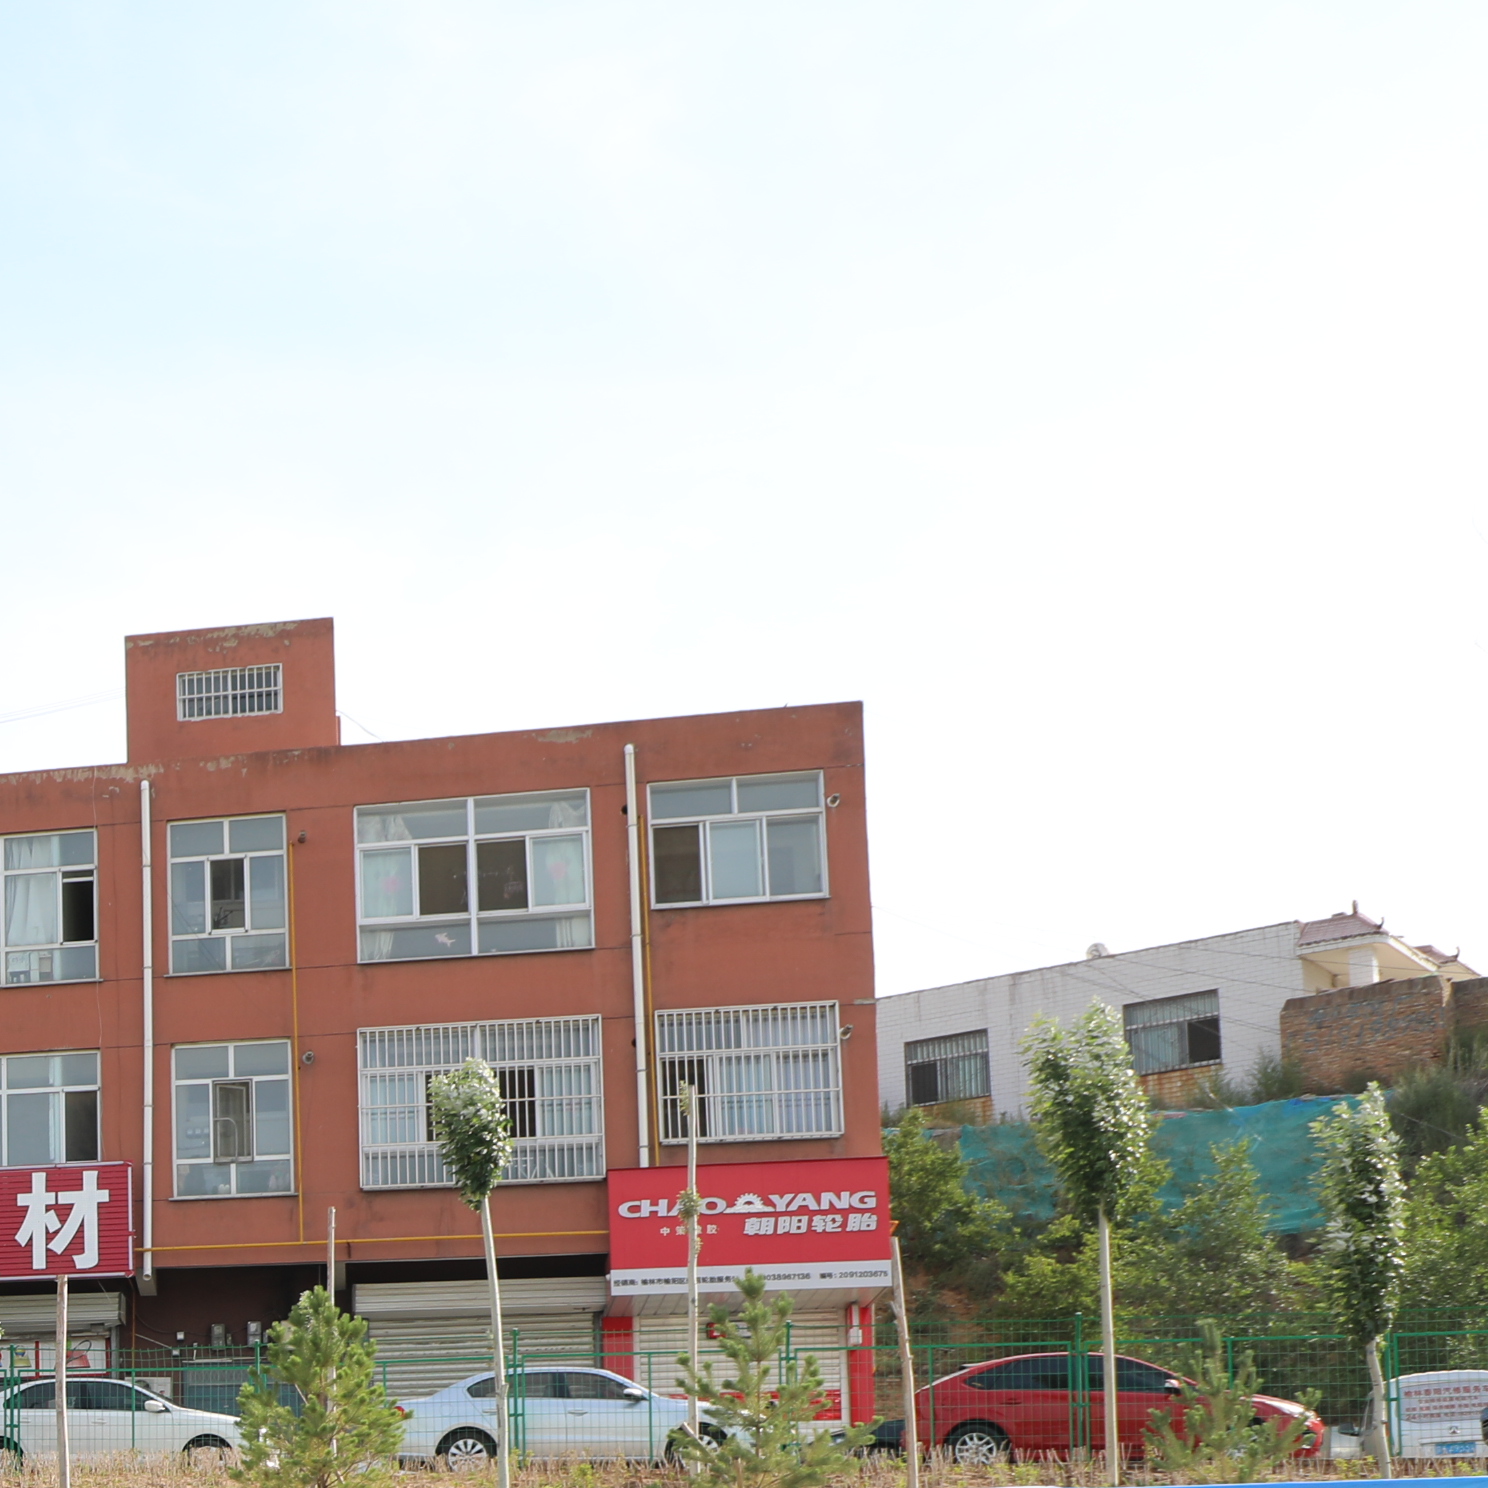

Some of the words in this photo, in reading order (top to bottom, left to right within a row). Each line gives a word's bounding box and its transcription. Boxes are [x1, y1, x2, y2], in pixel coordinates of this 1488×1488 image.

[768, 1191, 877, 1212] YANG
[743, 1213, 878, 1235] 朝阳轮胎
